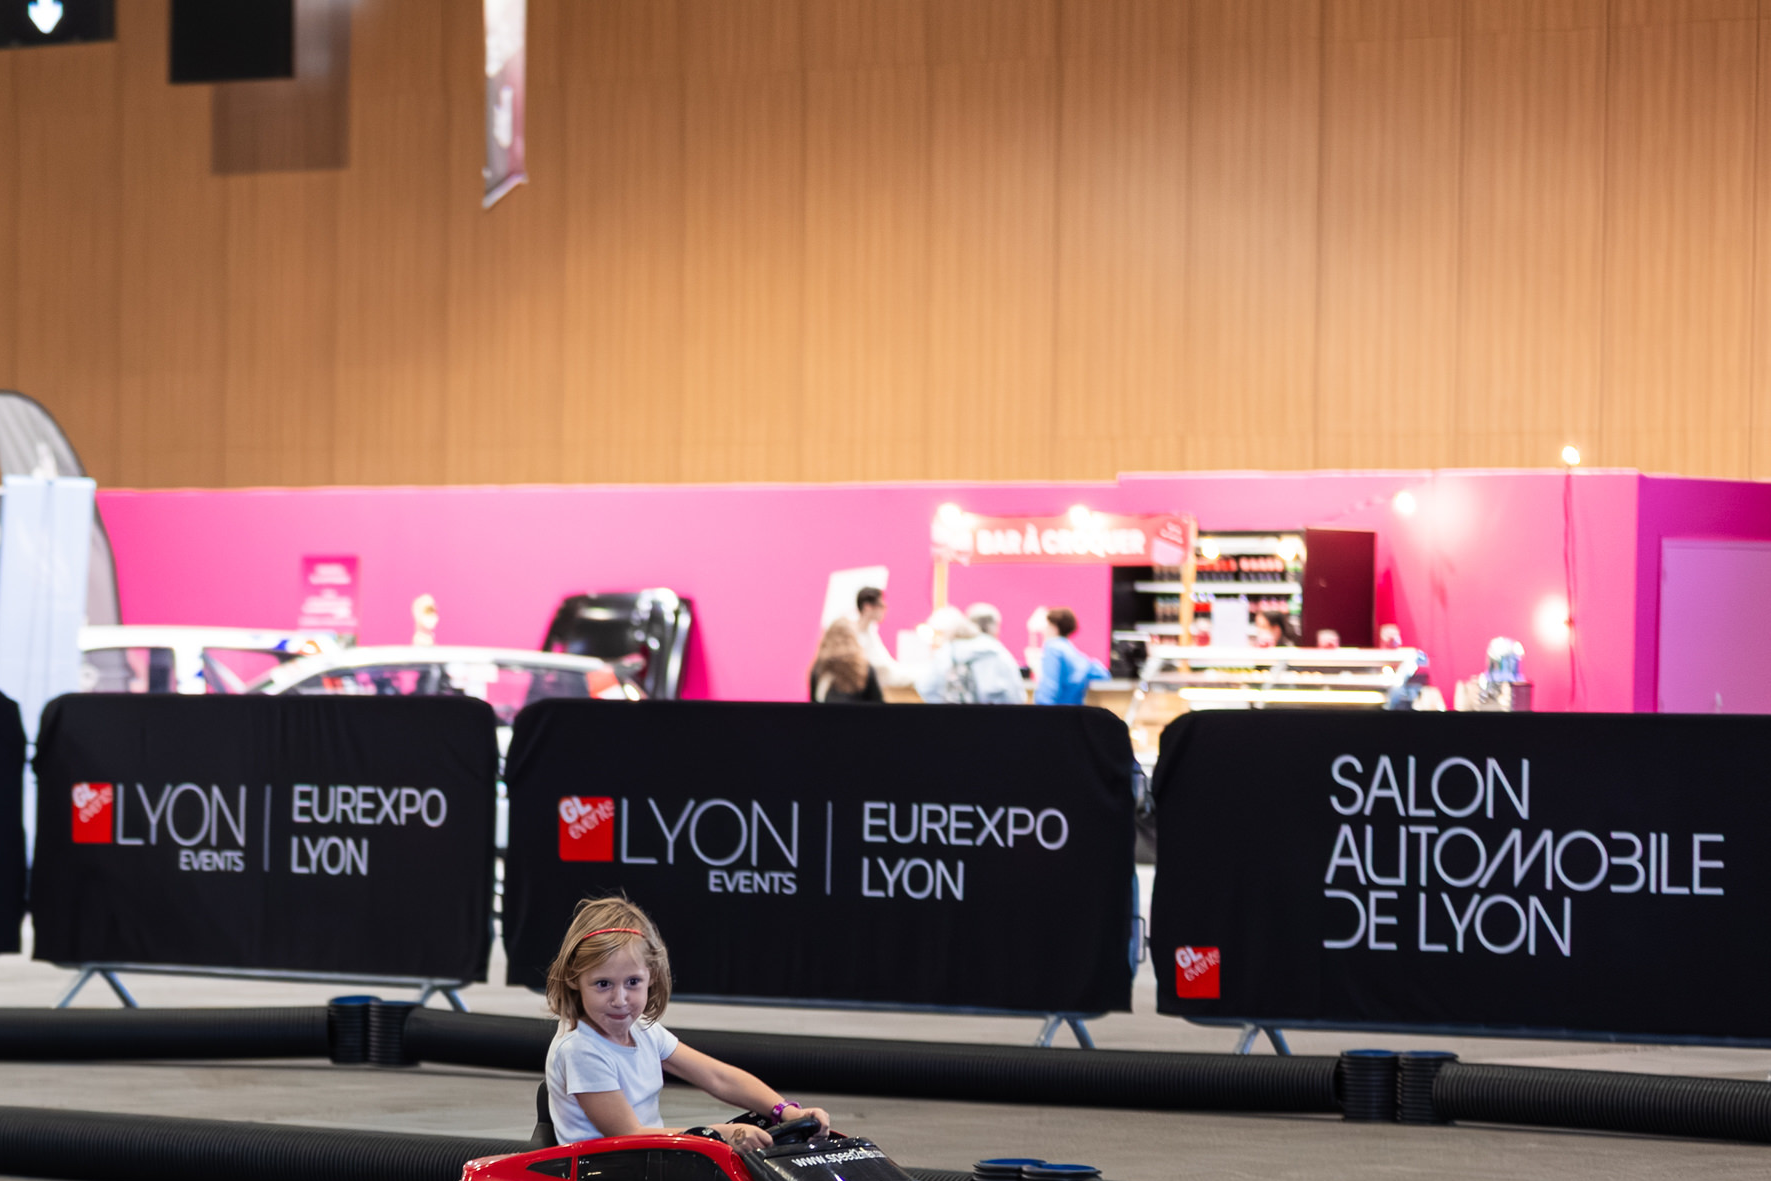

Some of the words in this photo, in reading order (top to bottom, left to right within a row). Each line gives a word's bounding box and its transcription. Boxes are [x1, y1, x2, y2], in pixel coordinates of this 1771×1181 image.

[292, 785, 448, 828] EUREXPO
[559, 796, 593, 824] GL
[1330, 755, 1530, 819] SALON
[117, 783, 247, 847] LYON
[621, 798, 799, 867] LYON
[863, 802, 1069, 851] EUREXPO
[179, 849, 245, 872] EVENTS
[291, 836, 369, 876] LYON
[1324, 824, 1725, 895] AUTOMOBILE
[708, 870, 797, 894] EVENTS
[862, 858, 965, 901] LYON
[1324, 890, 1398, 951] DE
[1419, 892, 1572, 957] LYON
